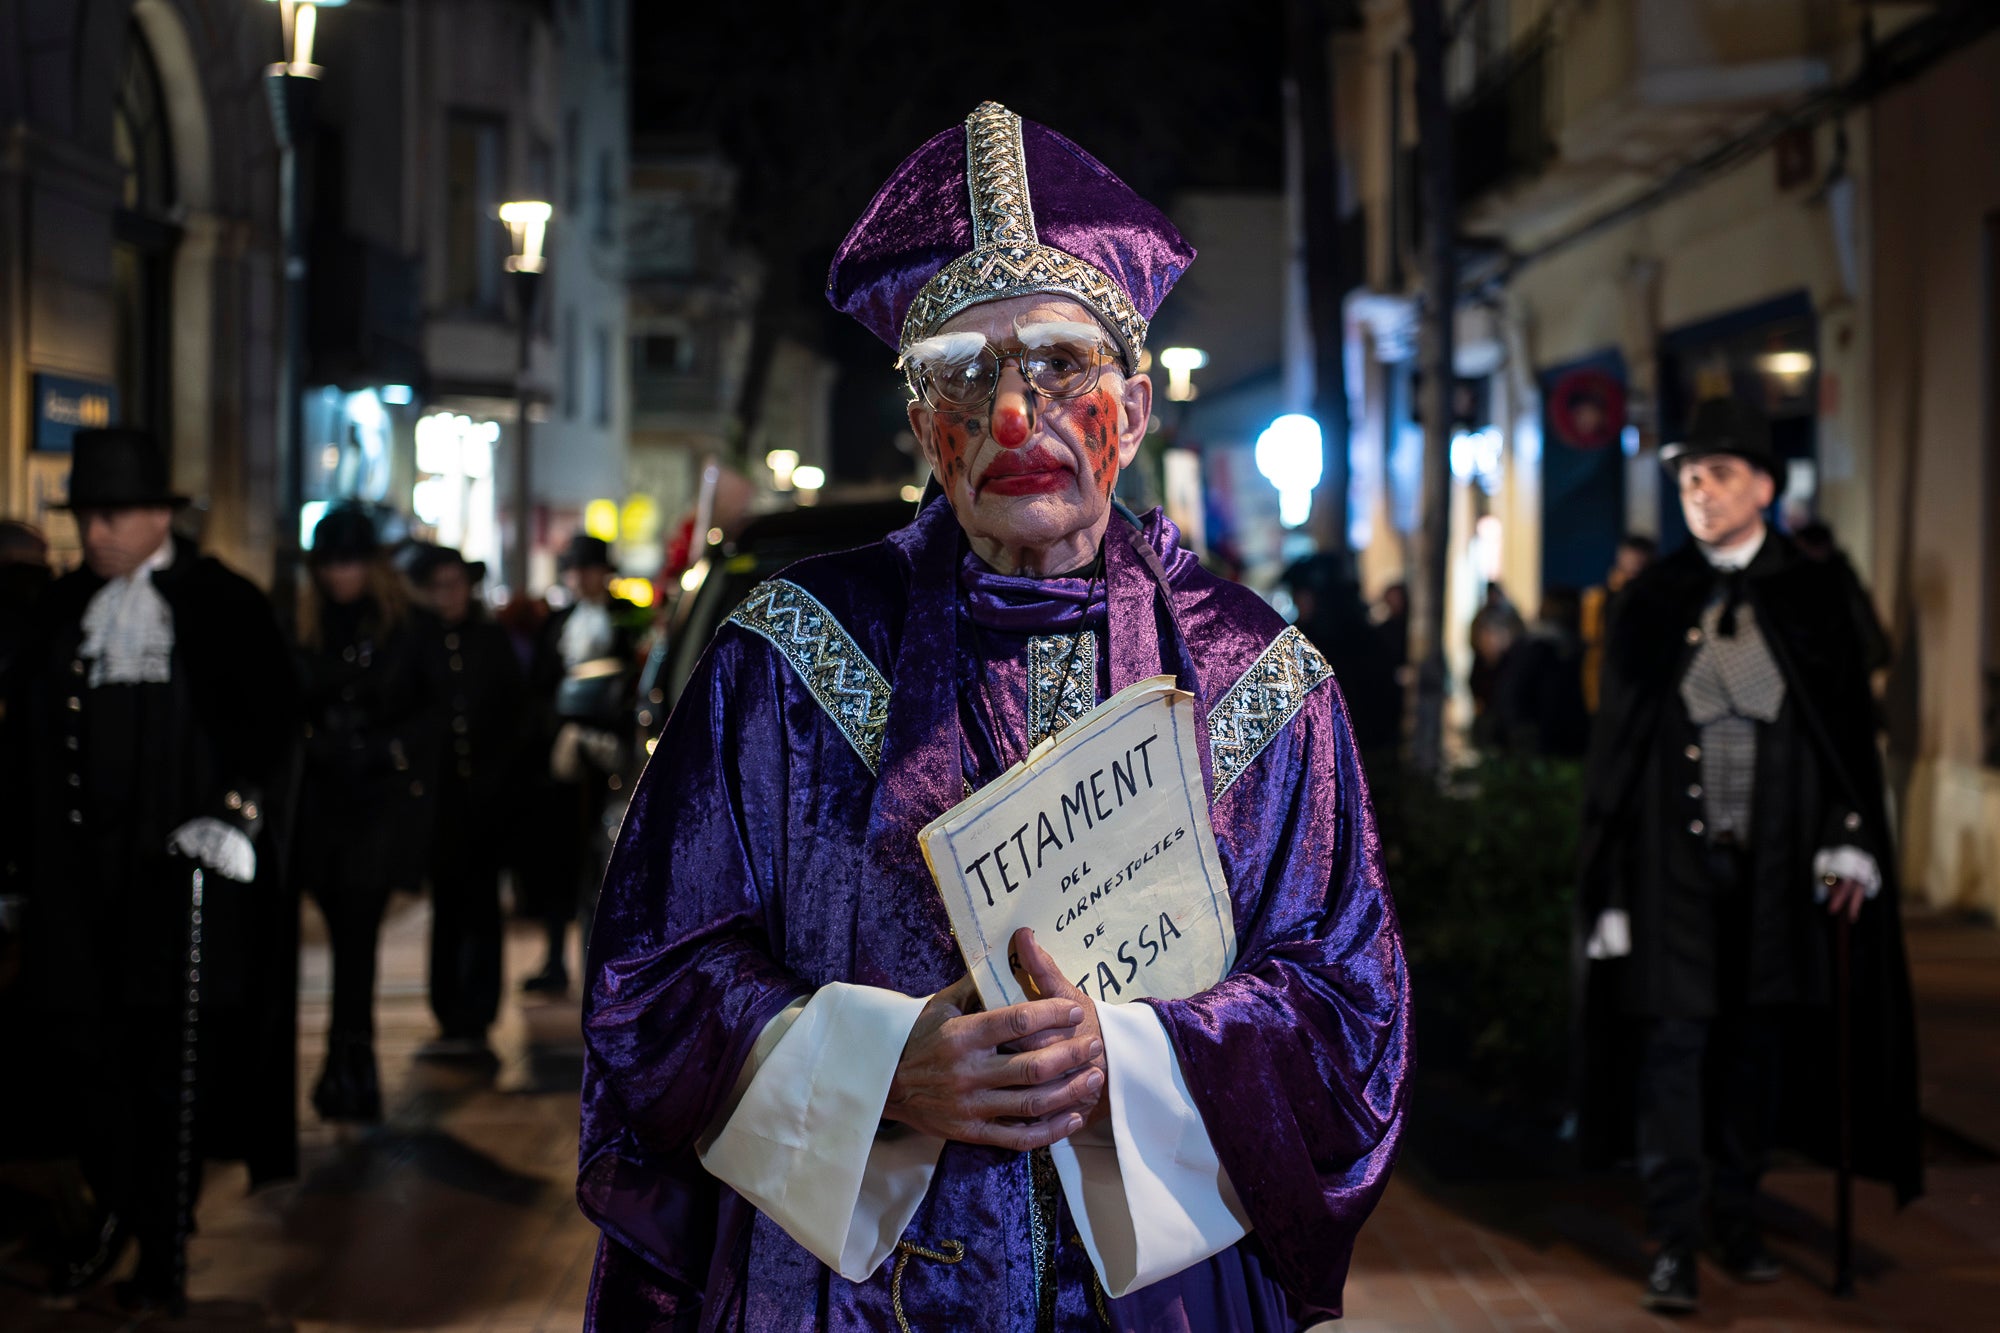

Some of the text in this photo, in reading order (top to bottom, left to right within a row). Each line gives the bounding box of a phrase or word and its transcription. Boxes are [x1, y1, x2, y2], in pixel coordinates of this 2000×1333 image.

[965, 734, 1157, 906] TETAMENT
[1056, 827, 1185, 932] CARNESTOLTES
[1061, 861, 1091, 893] DEL
[1083, 922, 1105, 949] DE
